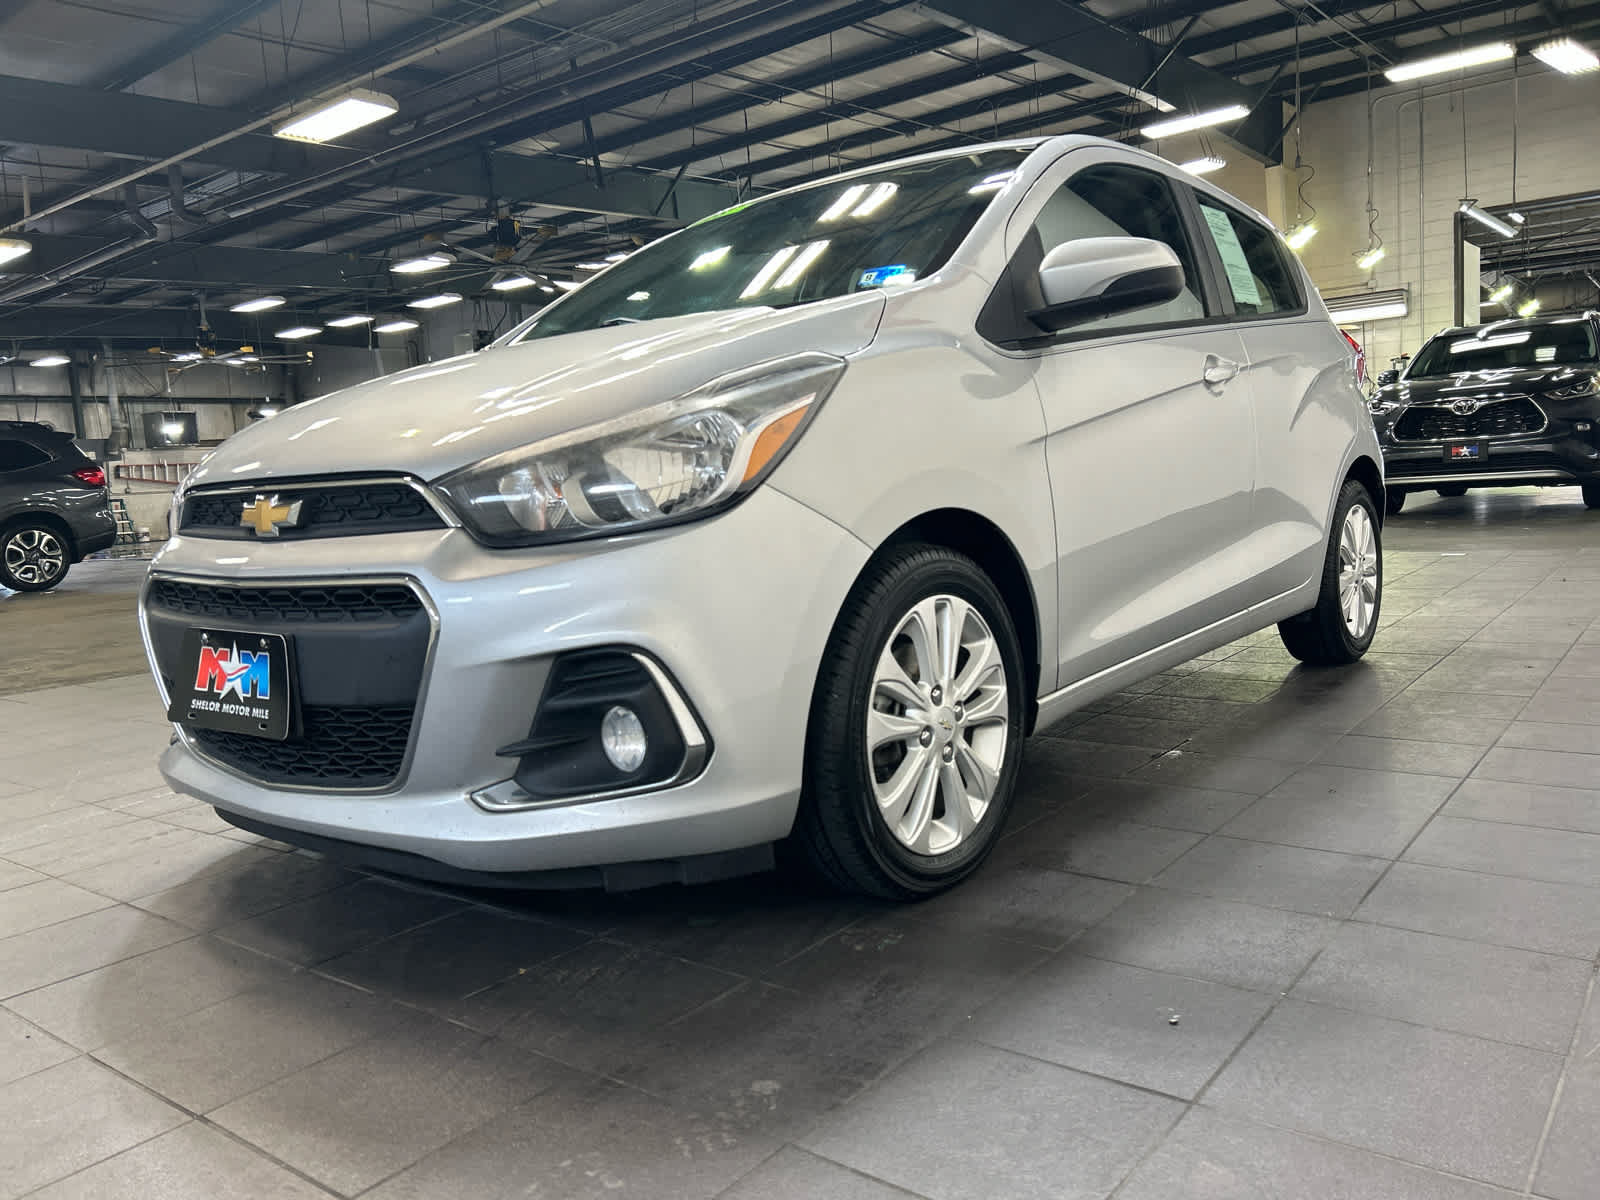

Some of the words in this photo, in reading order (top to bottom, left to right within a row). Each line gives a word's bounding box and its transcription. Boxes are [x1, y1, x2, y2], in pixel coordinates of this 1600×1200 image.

[190, 699, 221, 712] SHELOR
[221, 704, 250, 717] MOTOR
[251, 708, 269, 719] MILE
